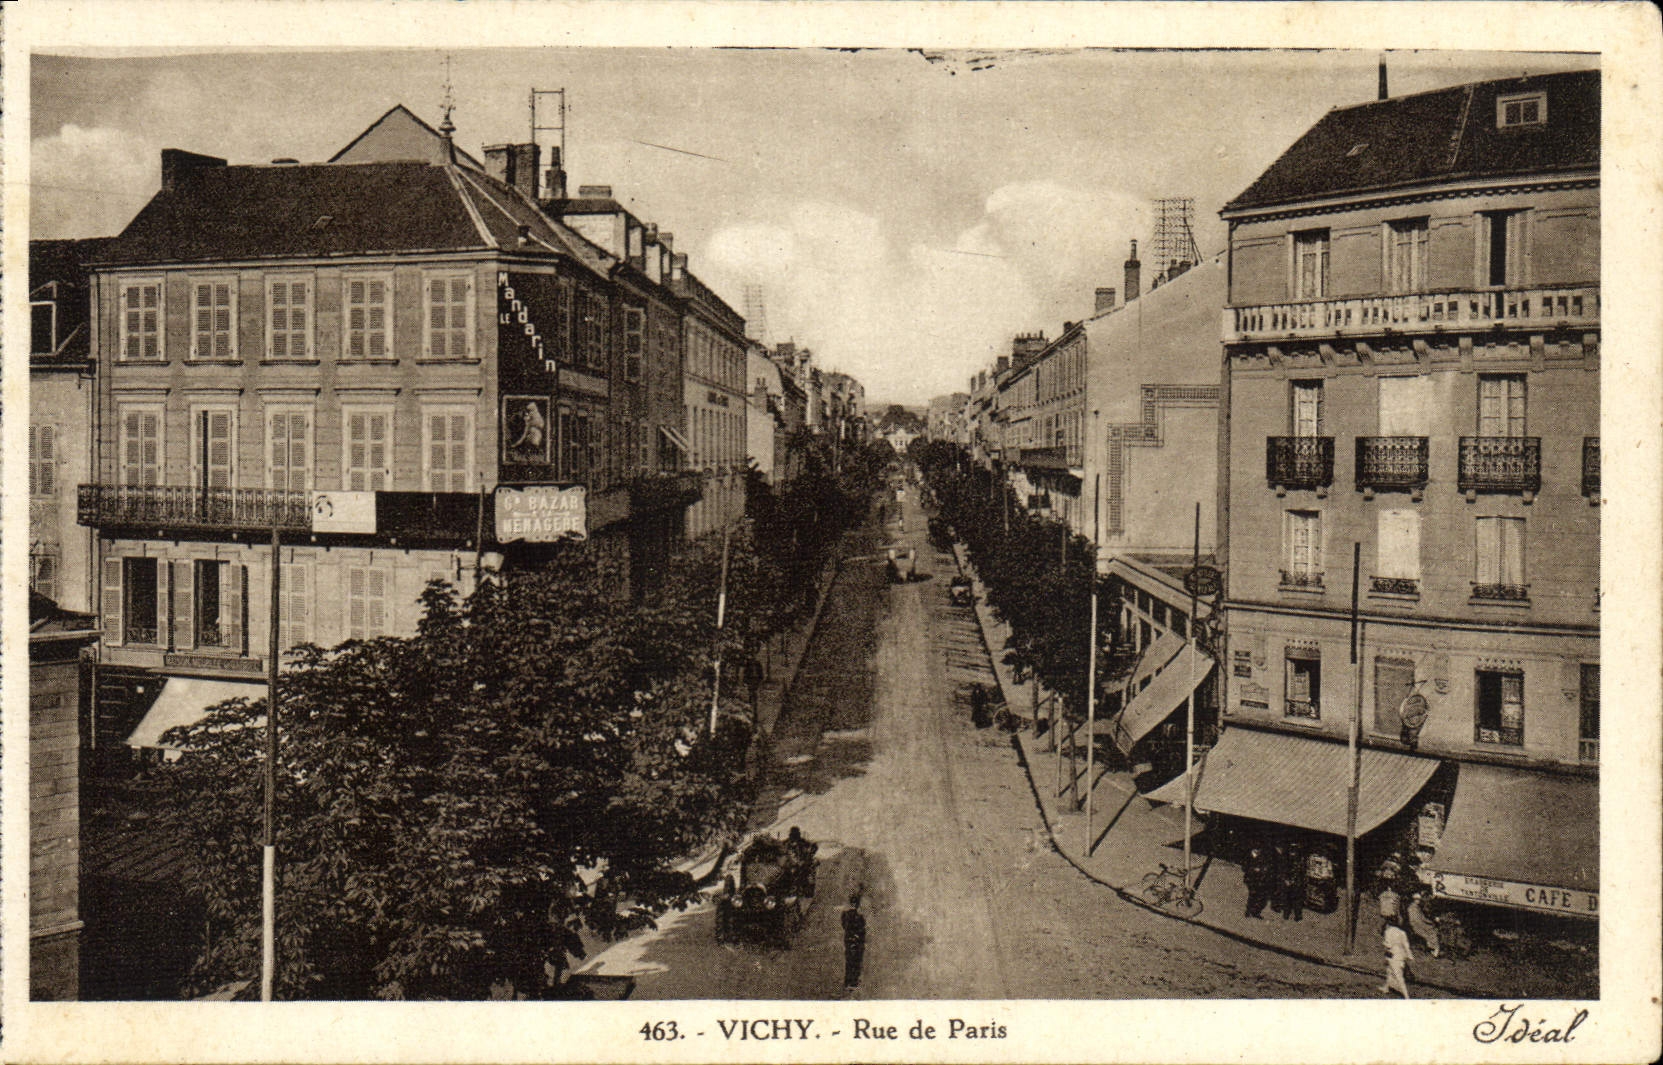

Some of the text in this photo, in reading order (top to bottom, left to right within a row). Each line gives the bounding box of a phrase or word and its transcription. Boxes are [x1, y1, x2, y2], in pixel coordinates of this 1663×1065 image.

[498, 272, 556, 373] Mandarin
[500, 313, 511, 325] LE
[528, 495, 578, 511] BAZAR
[1525, 887, 1572, 908] CAFE
